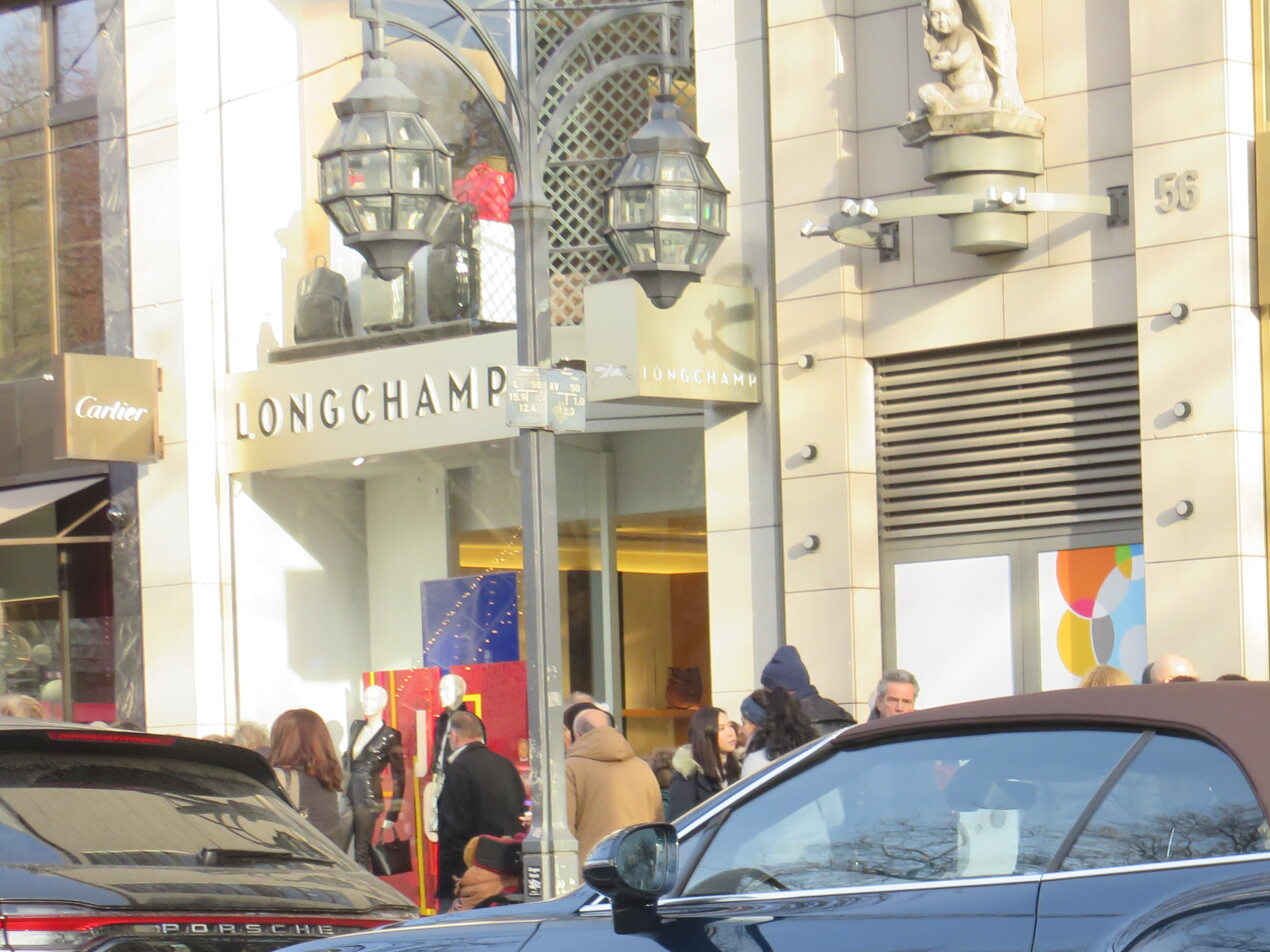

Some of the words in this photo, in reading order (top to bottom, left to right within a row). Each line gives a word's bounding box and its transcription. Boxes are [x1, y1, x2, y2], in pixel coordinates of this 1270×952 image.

[1154, 169, 1200, 215] 56
[642, 366, 758, 387] LONGCHAMP
[75, 395, 149, 422] Cartier
[236, 366, 508, 440] LONGCHAMP
[161, 922, 335, 936] PORSCHE
